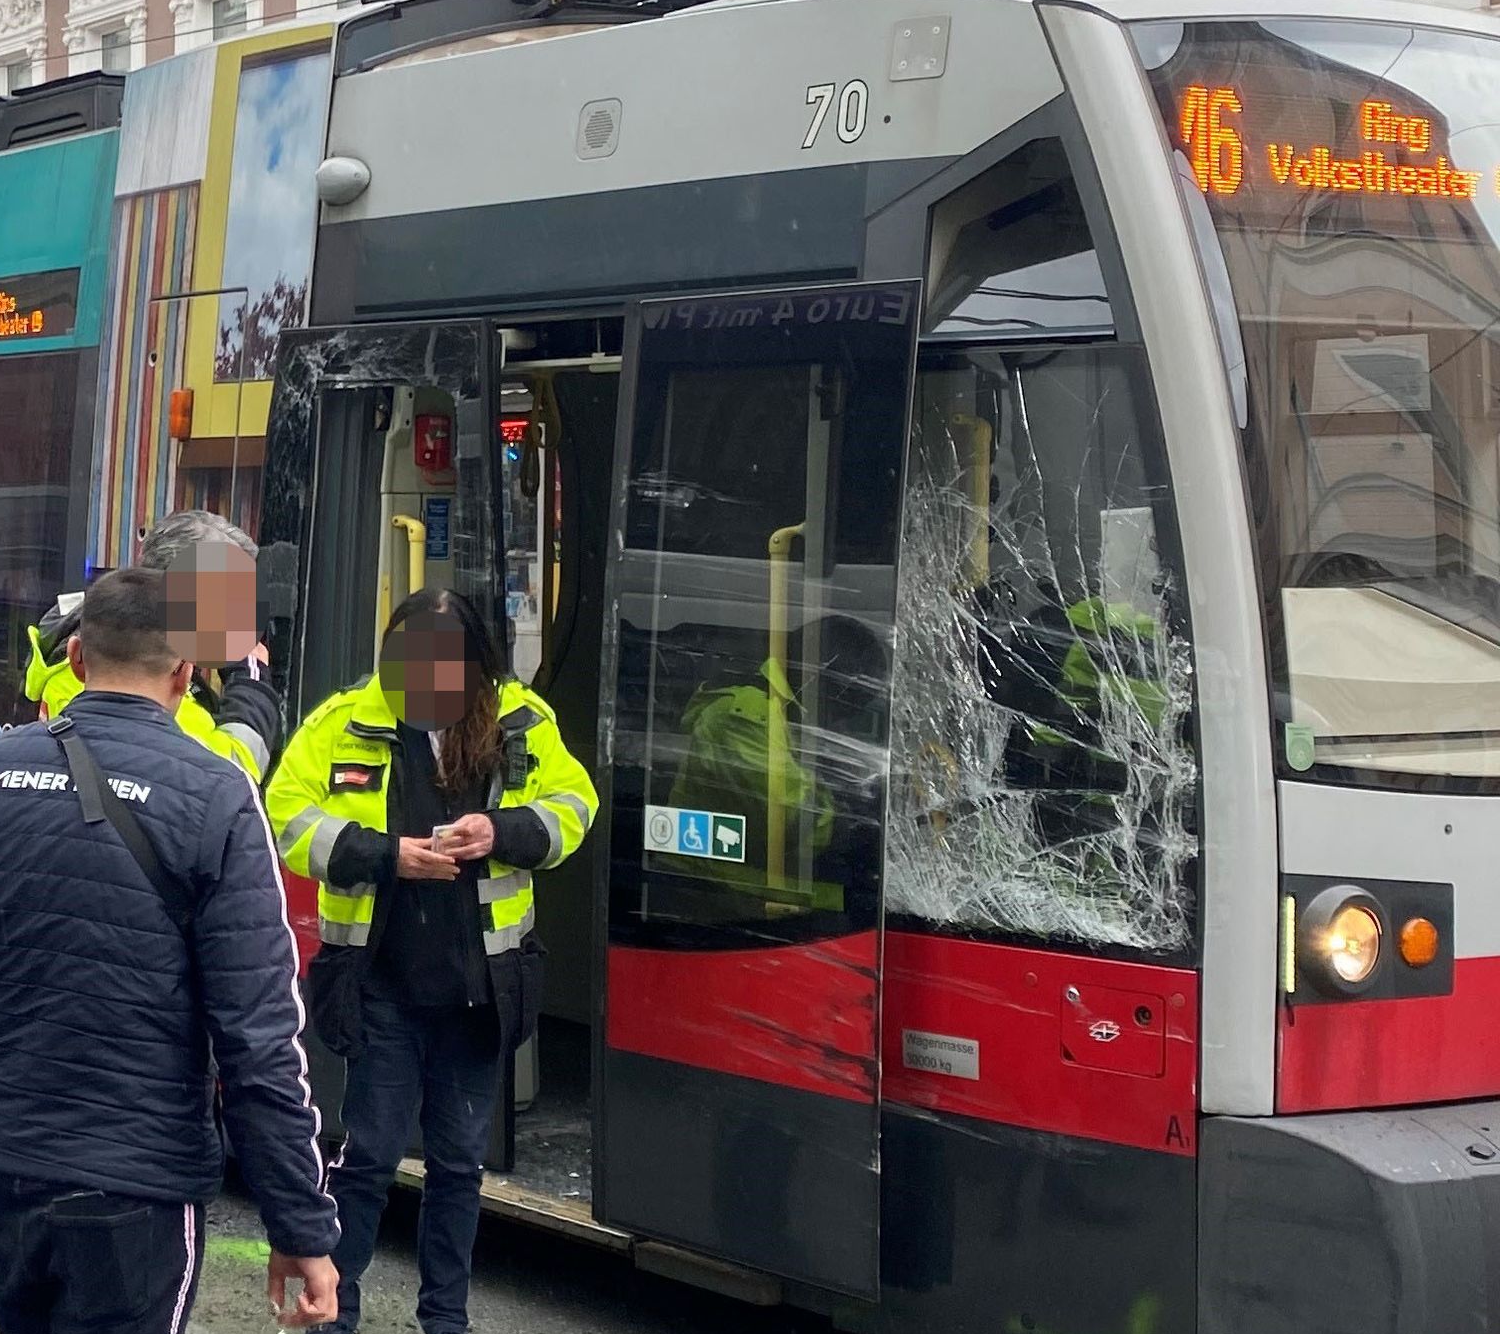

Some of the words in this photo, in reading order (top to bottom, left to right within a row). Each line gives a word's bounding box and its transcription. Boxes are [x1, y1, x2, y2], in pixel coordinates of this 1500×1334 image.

[801, 78, 869, 149] 70
[1361, 100, 1431, 153] Ring
[1267, 142, 1484, 199] Volkstheater
[905, 1032, 975, 1055] Wagenmasse
[939, 1058, 953, 1074] kg
